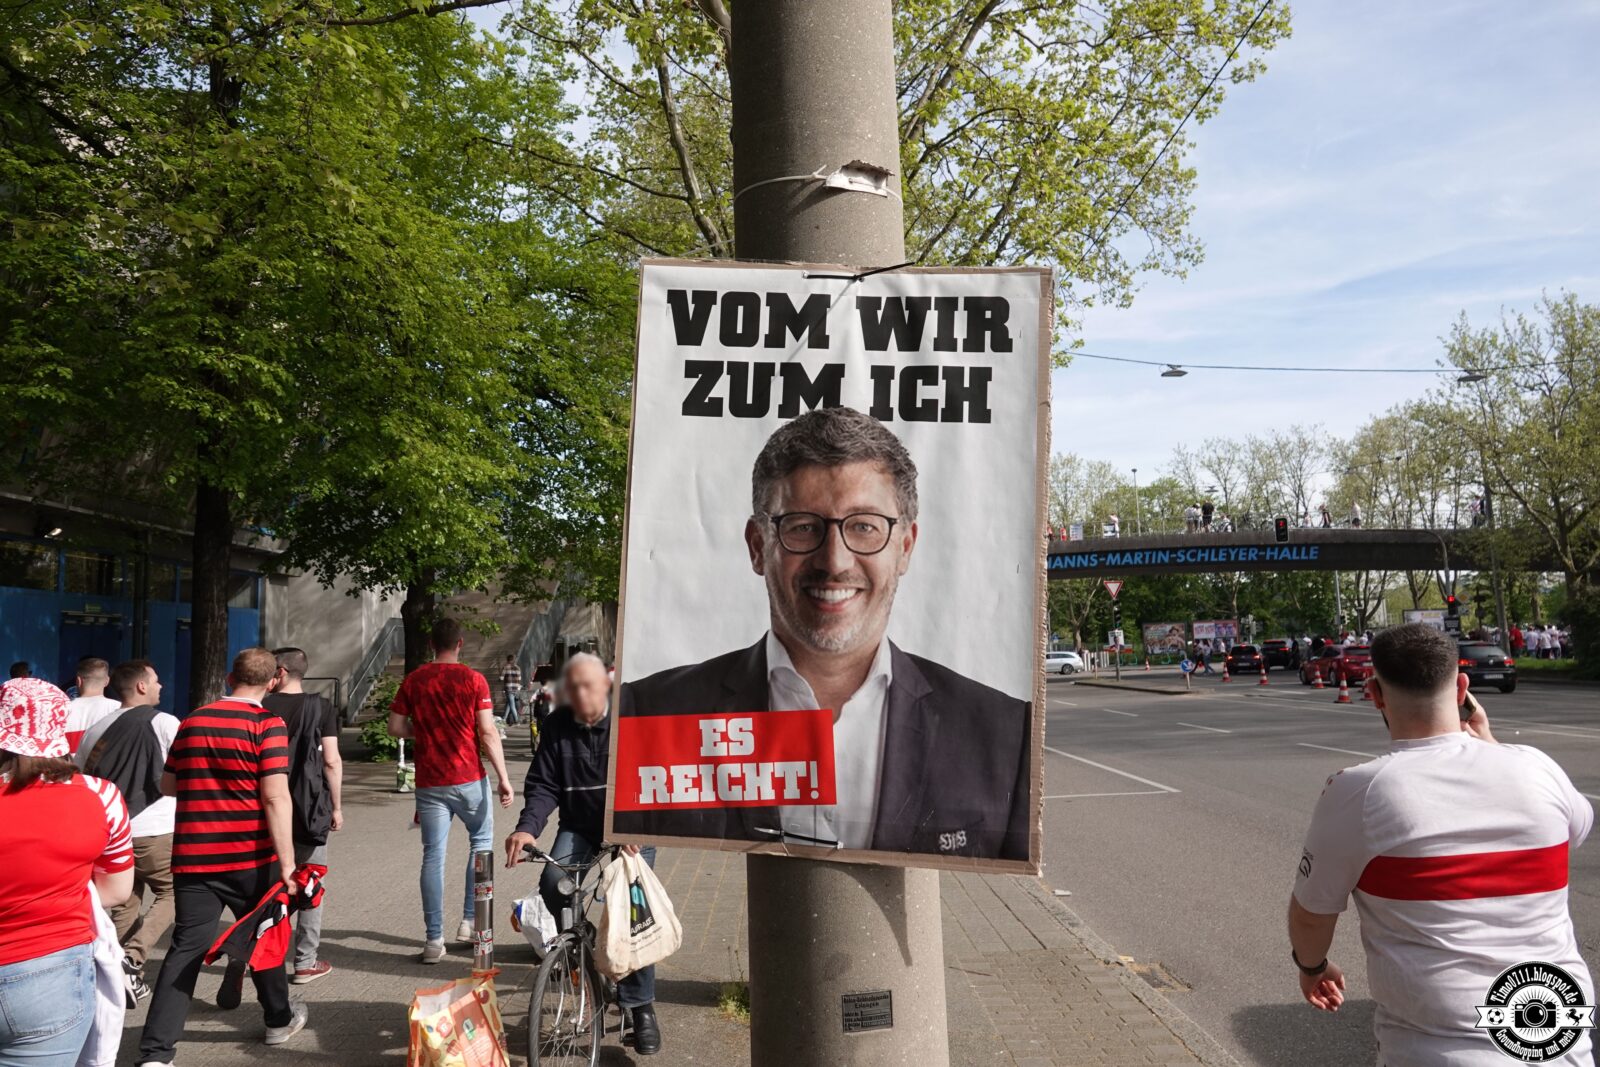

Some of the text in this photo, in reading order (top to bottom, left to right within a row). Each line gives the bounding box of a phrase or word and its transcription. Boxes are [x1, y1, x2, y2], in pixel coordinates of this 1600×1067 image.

[666, 289, 1014, 353] VOM WIR
[682, 360, 993, 423] ZUM ICH
[699, 717, 755, 756] ES
[638, 760, 820, 803] REICHT!
